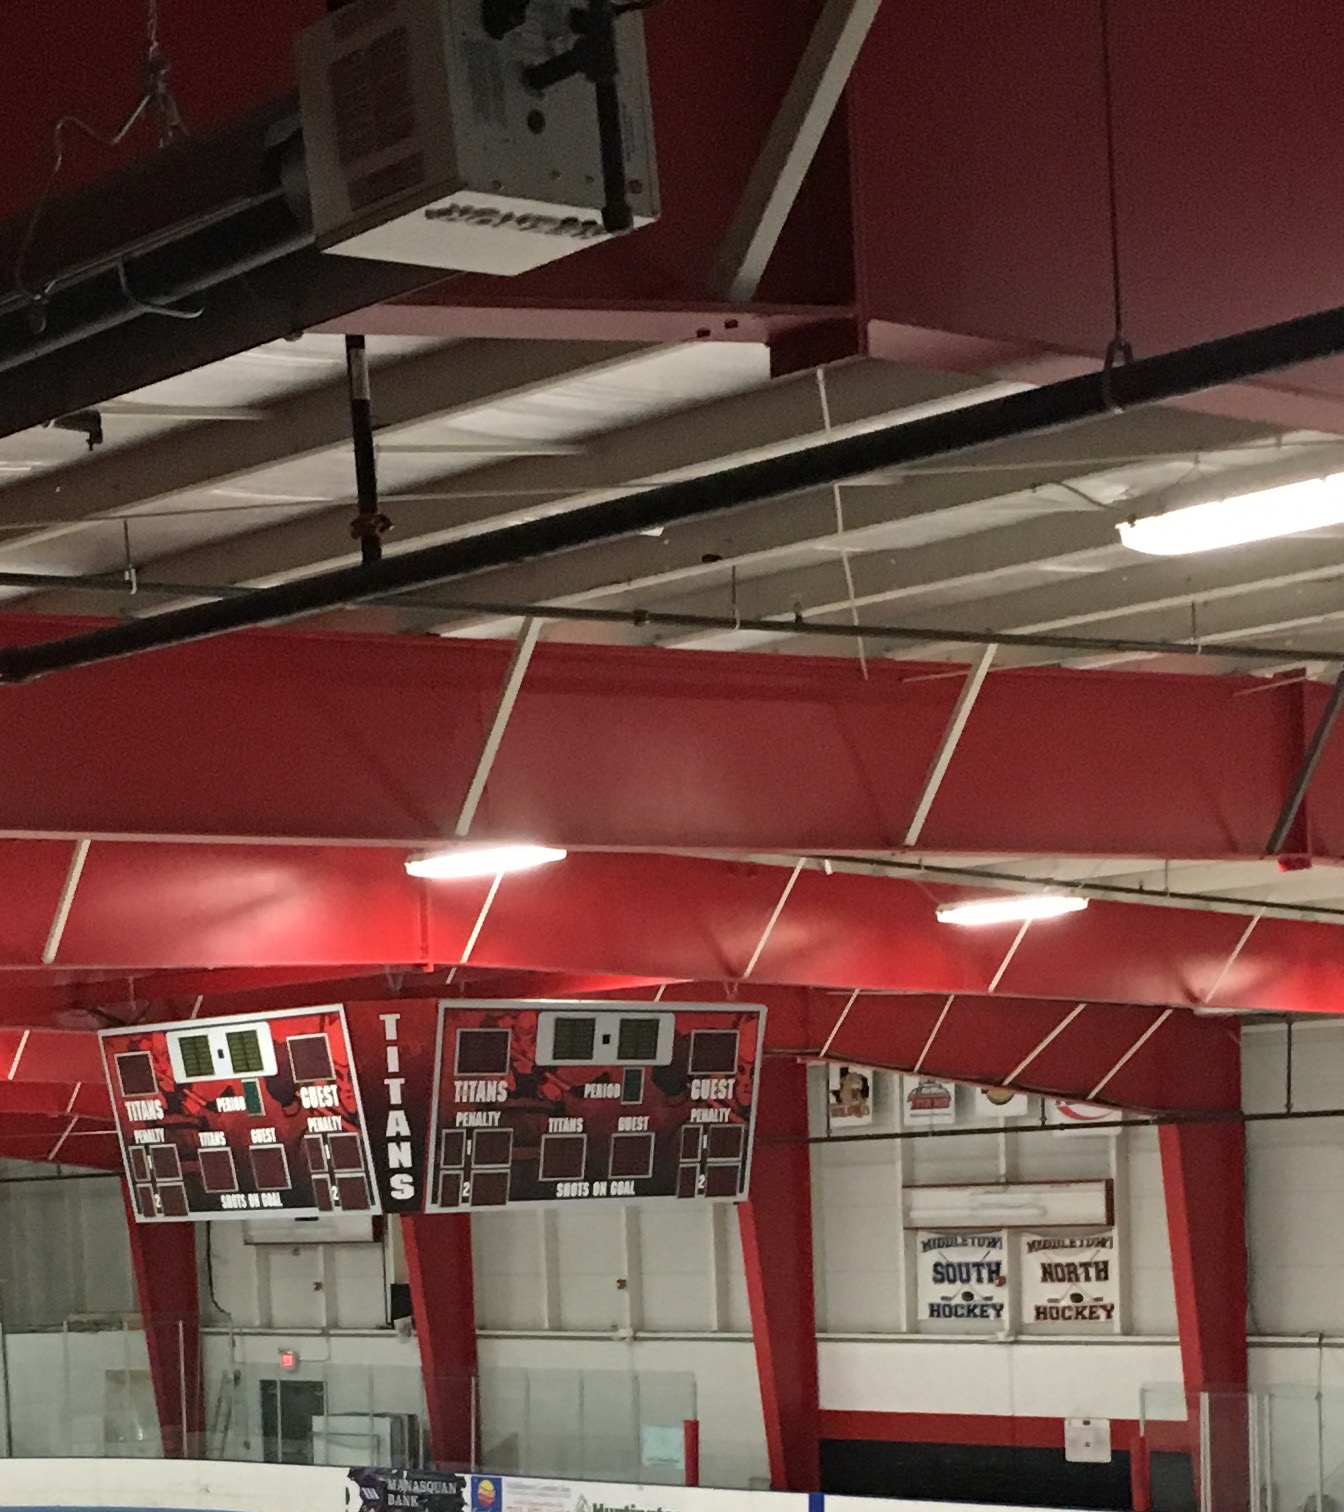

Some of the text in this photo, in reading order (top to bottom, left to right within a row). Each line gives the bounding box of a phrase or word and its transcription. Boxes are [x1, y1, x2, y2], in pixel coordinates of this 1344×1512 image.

[300, 1085, 340, 1108] GUEST
[454, 1080, 508, 1103] TITANS
[584, 1082, 620, 1099] PERIOD
[690, 1078, 735, 1100] GUEST
[125, 1100, 165, 1121] TITANS
[216, 1096, 246, 1112] PERIOD
[379, 1013, 415, 1200] TITANS
[307, 1115, 343, 1132] PENALTY
[456, 1111, 501, 1127] PENALTY
[618, 1115, 650, 1132] GUEST
[690, 1108, 731, 1124] PENALTY
[548, 1117, 584, 1133] TITANS
[133, 1128, 165, 1143] PENALTY
[198, 1131, 226, 1146] TITANS
[250, 1127, 276, 1143] GUEST
[556, 1180, 635, 1197] SHOTS ON GOAL
[220, 1194, 246, 1208] SHOTS
[932, 1260, 1003, 1285] SOUTH
[1040, 1260, 1110, 1284] NORTH
[928, 1302, 1004, 1319] HOCKEY
[1034, 1303, 1115, 1321] HOCKEY
[387, 1479, 456, 1494] MANASQUAN
[387, 1493, 419, 1507] BANK
